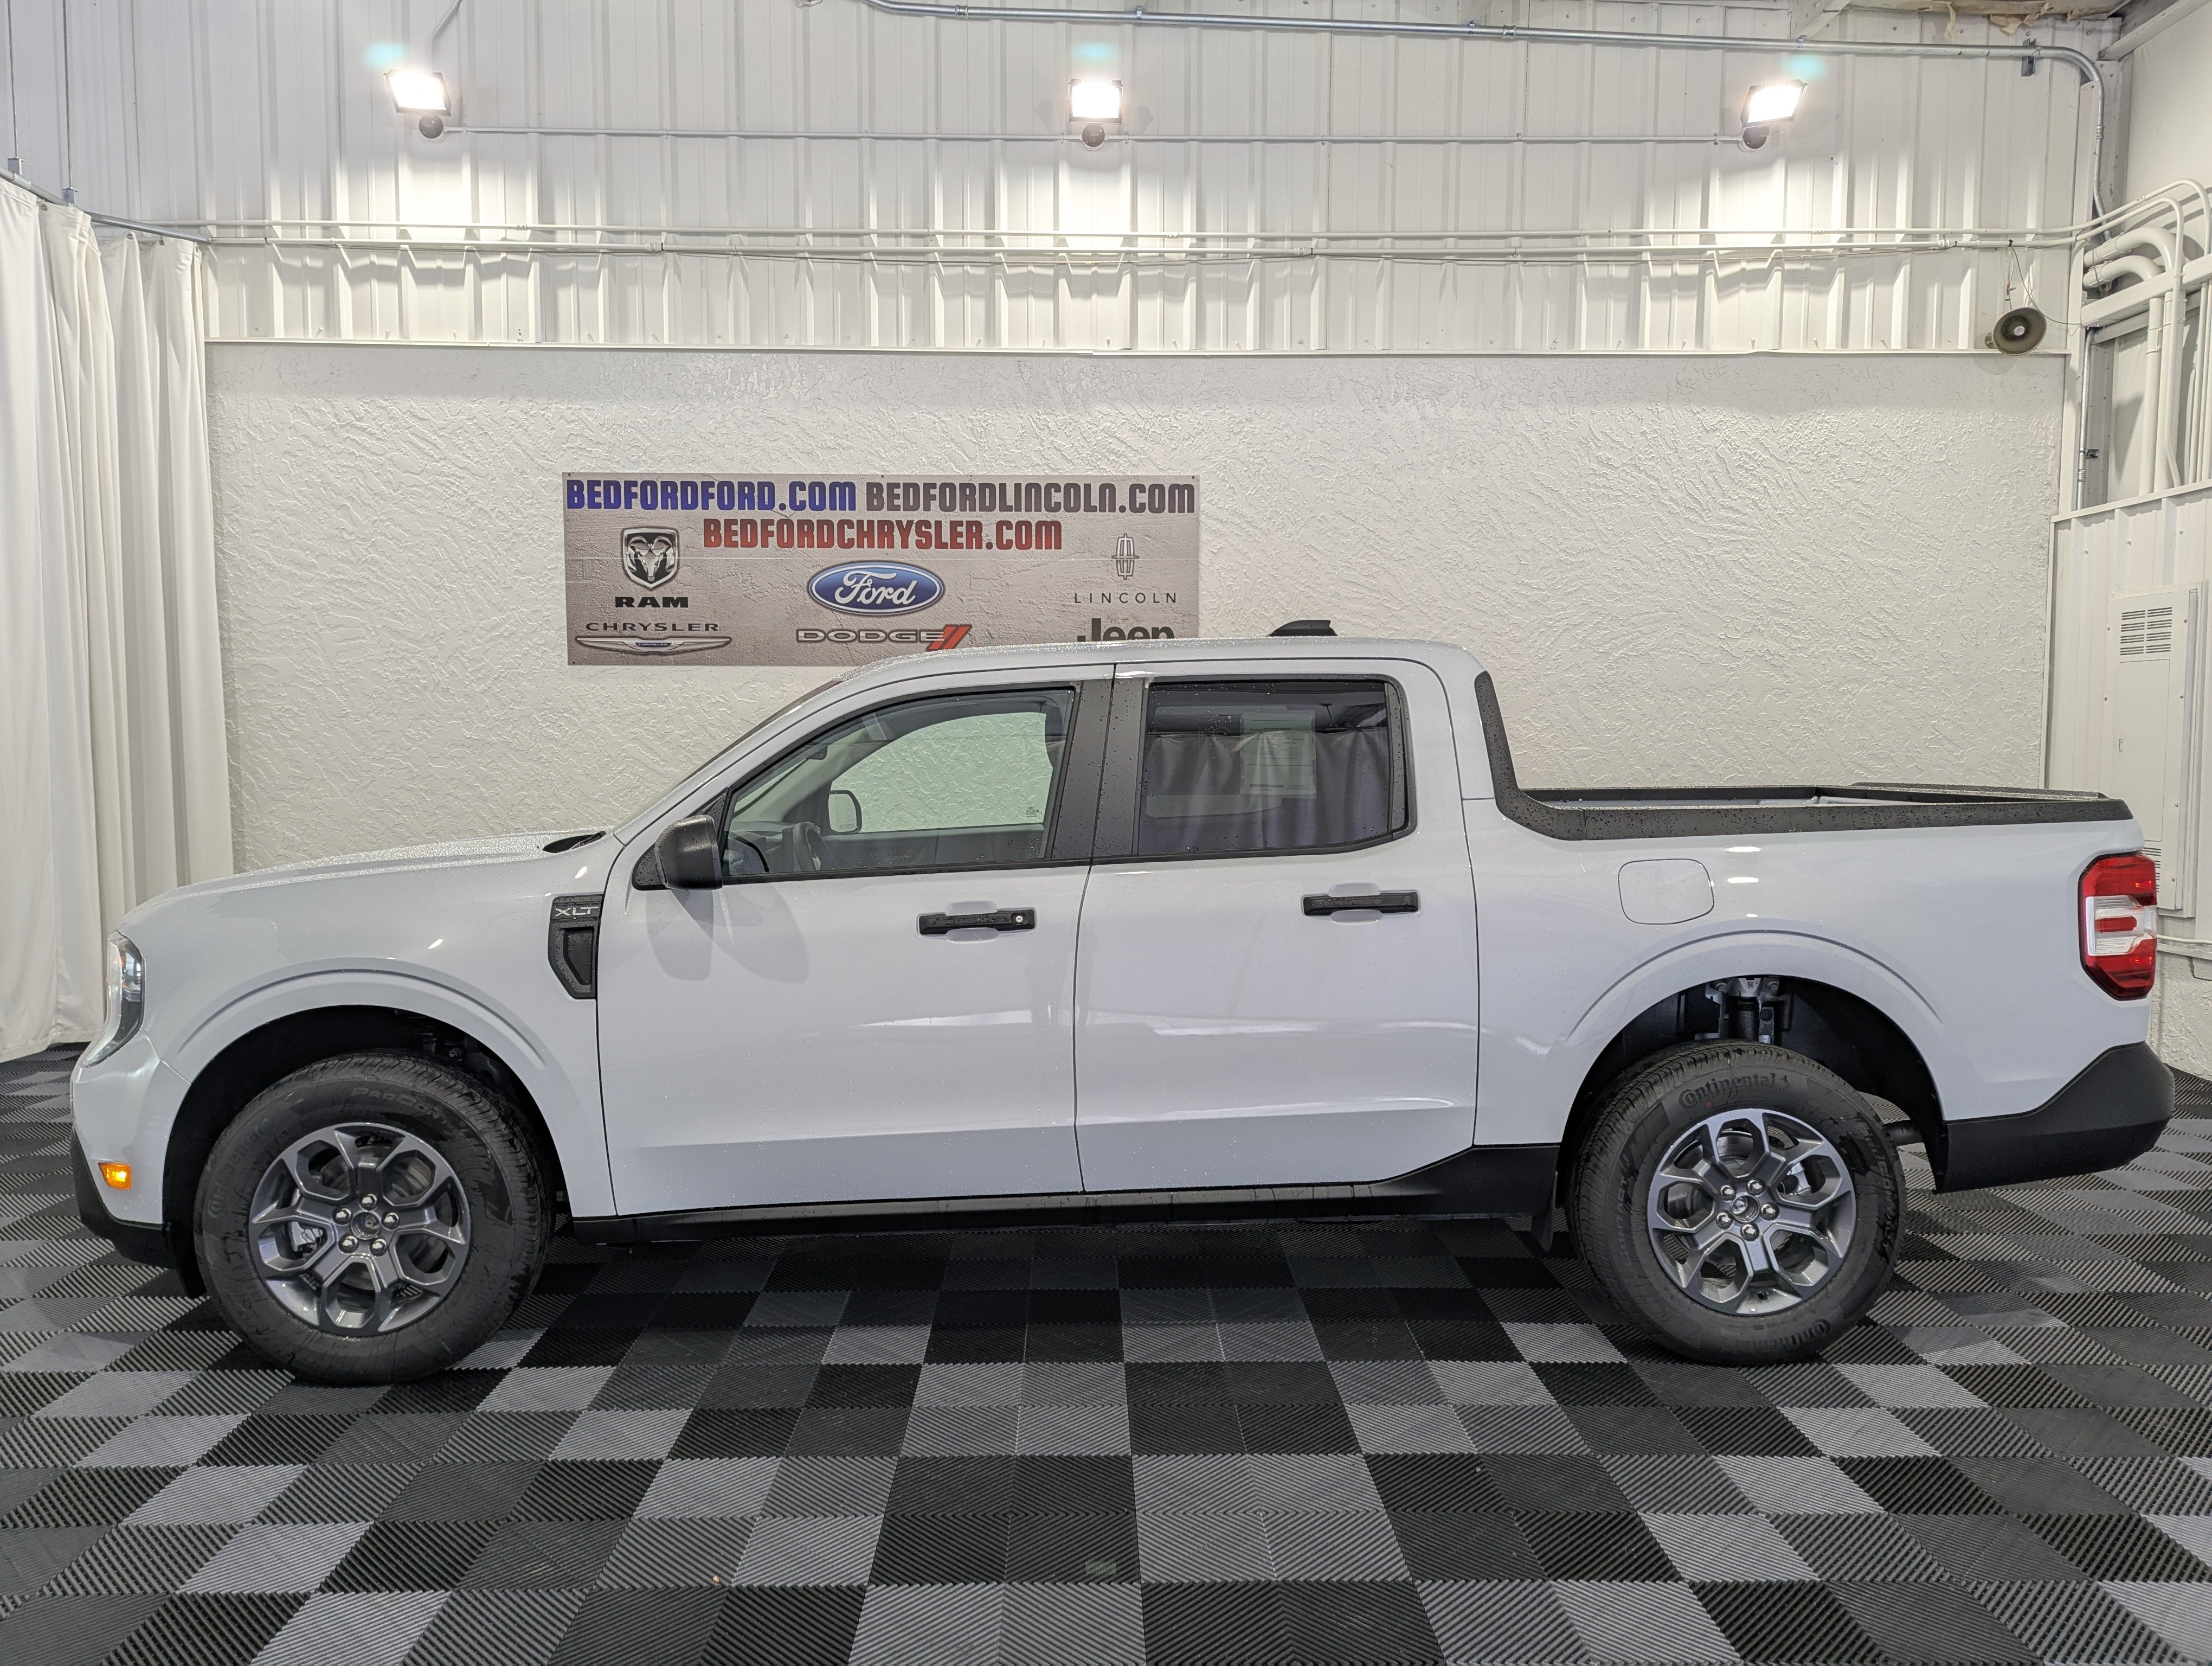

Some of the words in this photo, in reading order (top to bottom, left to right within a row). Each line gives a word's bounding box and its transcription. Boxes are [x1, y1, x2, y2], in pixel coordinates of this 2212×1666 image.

[567, 479, 856, 511] BEDFORDFORD.COM
[866, 482, 1195, 514] BEDFORDLINCOLN.COM
[704, 518, 1062, 550] BEDFORDCHRYSLER.COM
[834, 571, 918, 605] Ford
[615, 596, 689, 608] RAM
[1075, 592, 1176, 604] LINCOLN
[586, 623, 719, 632] CHRYSLER
[797, 629, 945, 643] DODGE
[554, 906, 599, 917] XLT
[1679, 1073, 1776, 1109] Continental
